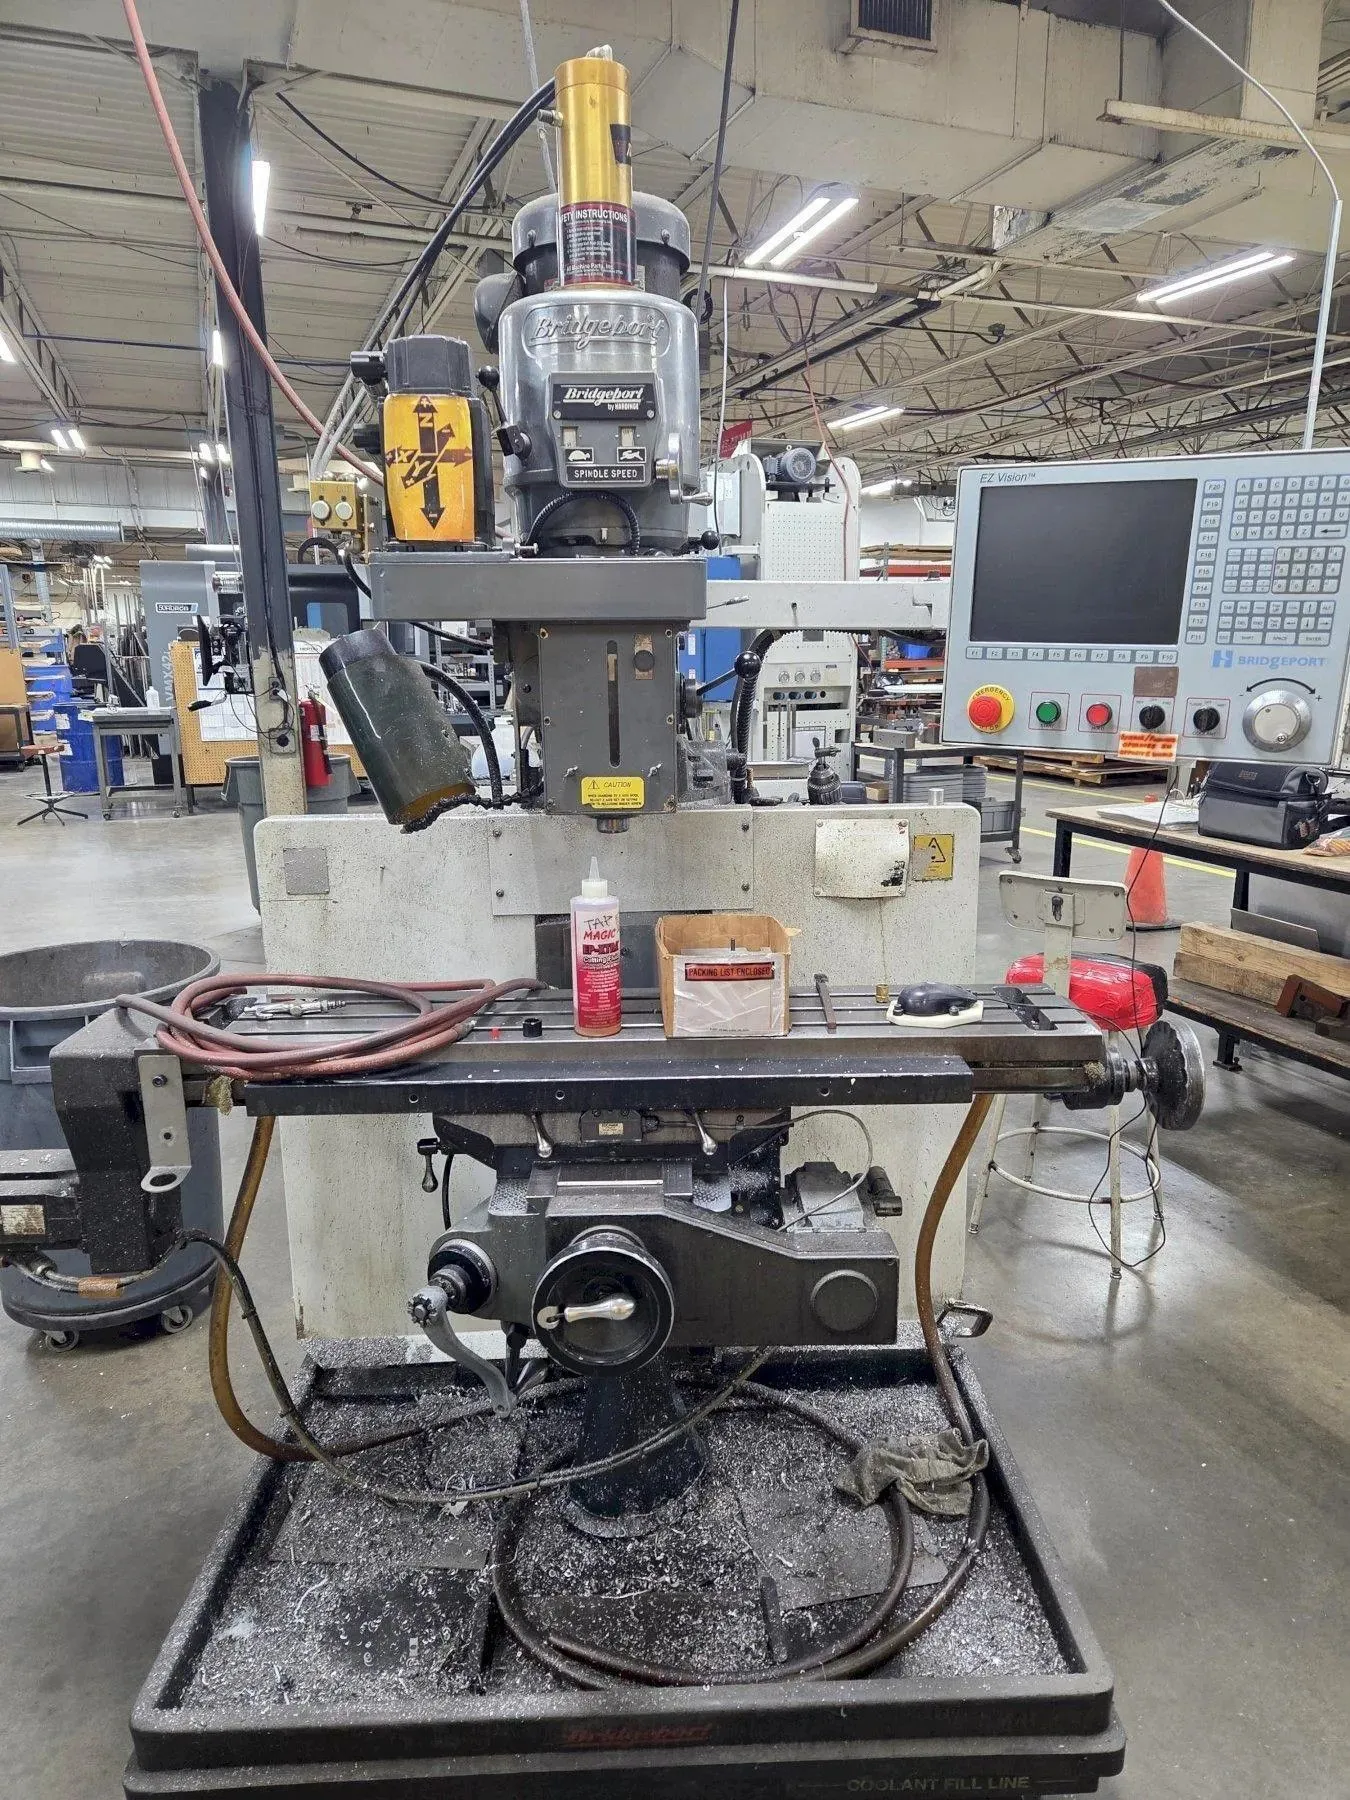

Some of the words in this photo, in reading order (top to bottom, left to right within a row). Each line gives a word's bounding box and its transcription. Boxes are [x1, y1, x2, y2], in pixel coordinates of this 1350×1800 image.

[575, 209, 628, 222] INSTRUCTIONS
[531, 315, 664, 350] Bridgeport
[564, 387, 644, 406] Bridgeport
[607, 403, 615, 411] by
[574, 469, 609, 478] SPINDLE
[611, 469, 638, 478] SPEED
[980, 473, 995, 483] EZ
[584, 915, 613, 931] TAP
[584, 929, 616, 940] MAGIC
[689, 968, 718, 977] PACKING
[720, 968, 734, 977] LIST
[736, 966, 771, 976] ENCLOSED
[847, 1778, 940, 1792] COOLANT
[943, 1778, 983, 1790] FILL
[987, 1776, 1031, 1789] LINE
